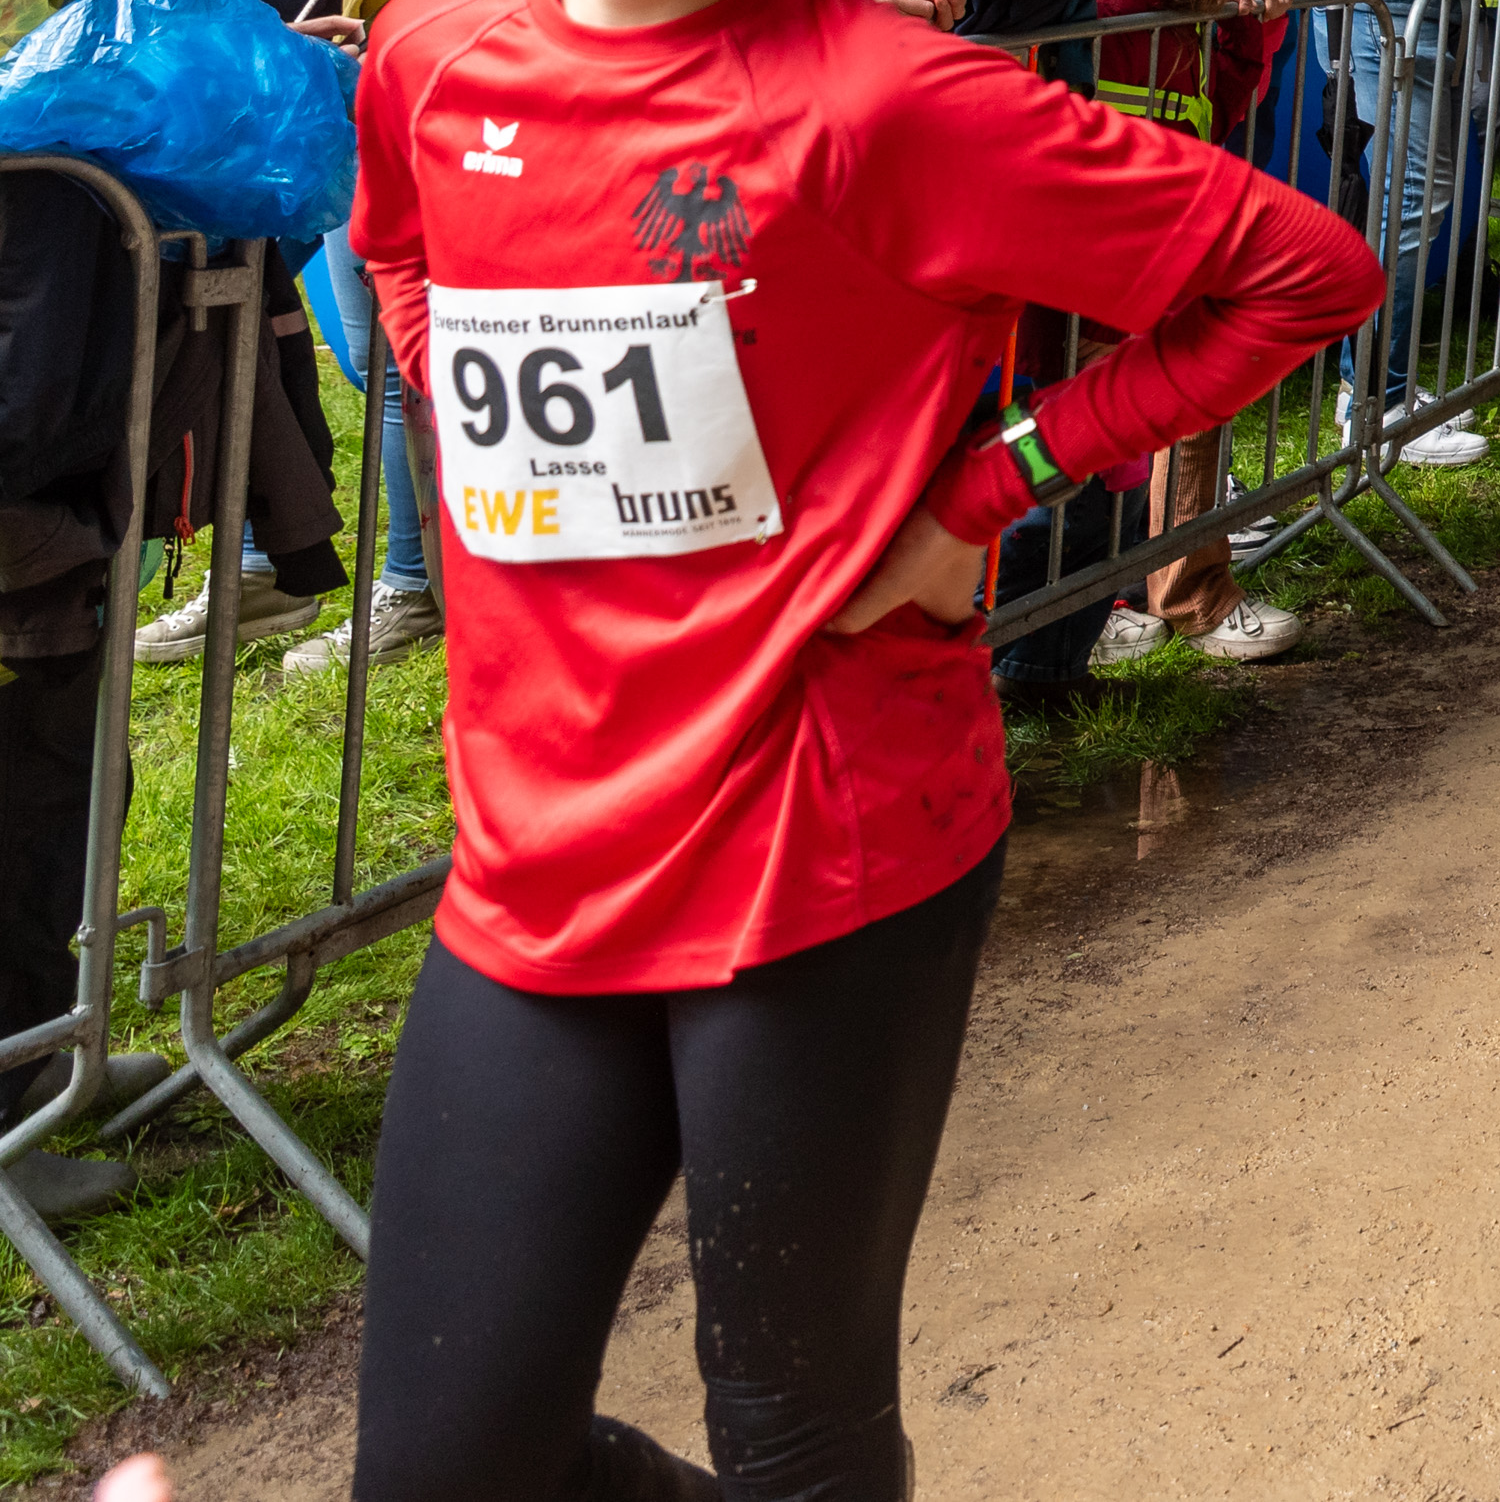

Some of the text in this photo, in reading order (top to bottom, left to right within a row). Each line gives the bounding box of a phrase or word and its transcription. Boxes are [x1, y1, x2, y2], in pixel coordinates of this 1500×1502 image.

[463, 150, 524, 178] erima
[539, 307, 700, 333] Brunnenlauf
[452, 343, 672, 447] 961
[530, 458, 608, 477] Lasse
[463, 485, 561, 536] EWE
[612, 483, 738, 525] bruns
